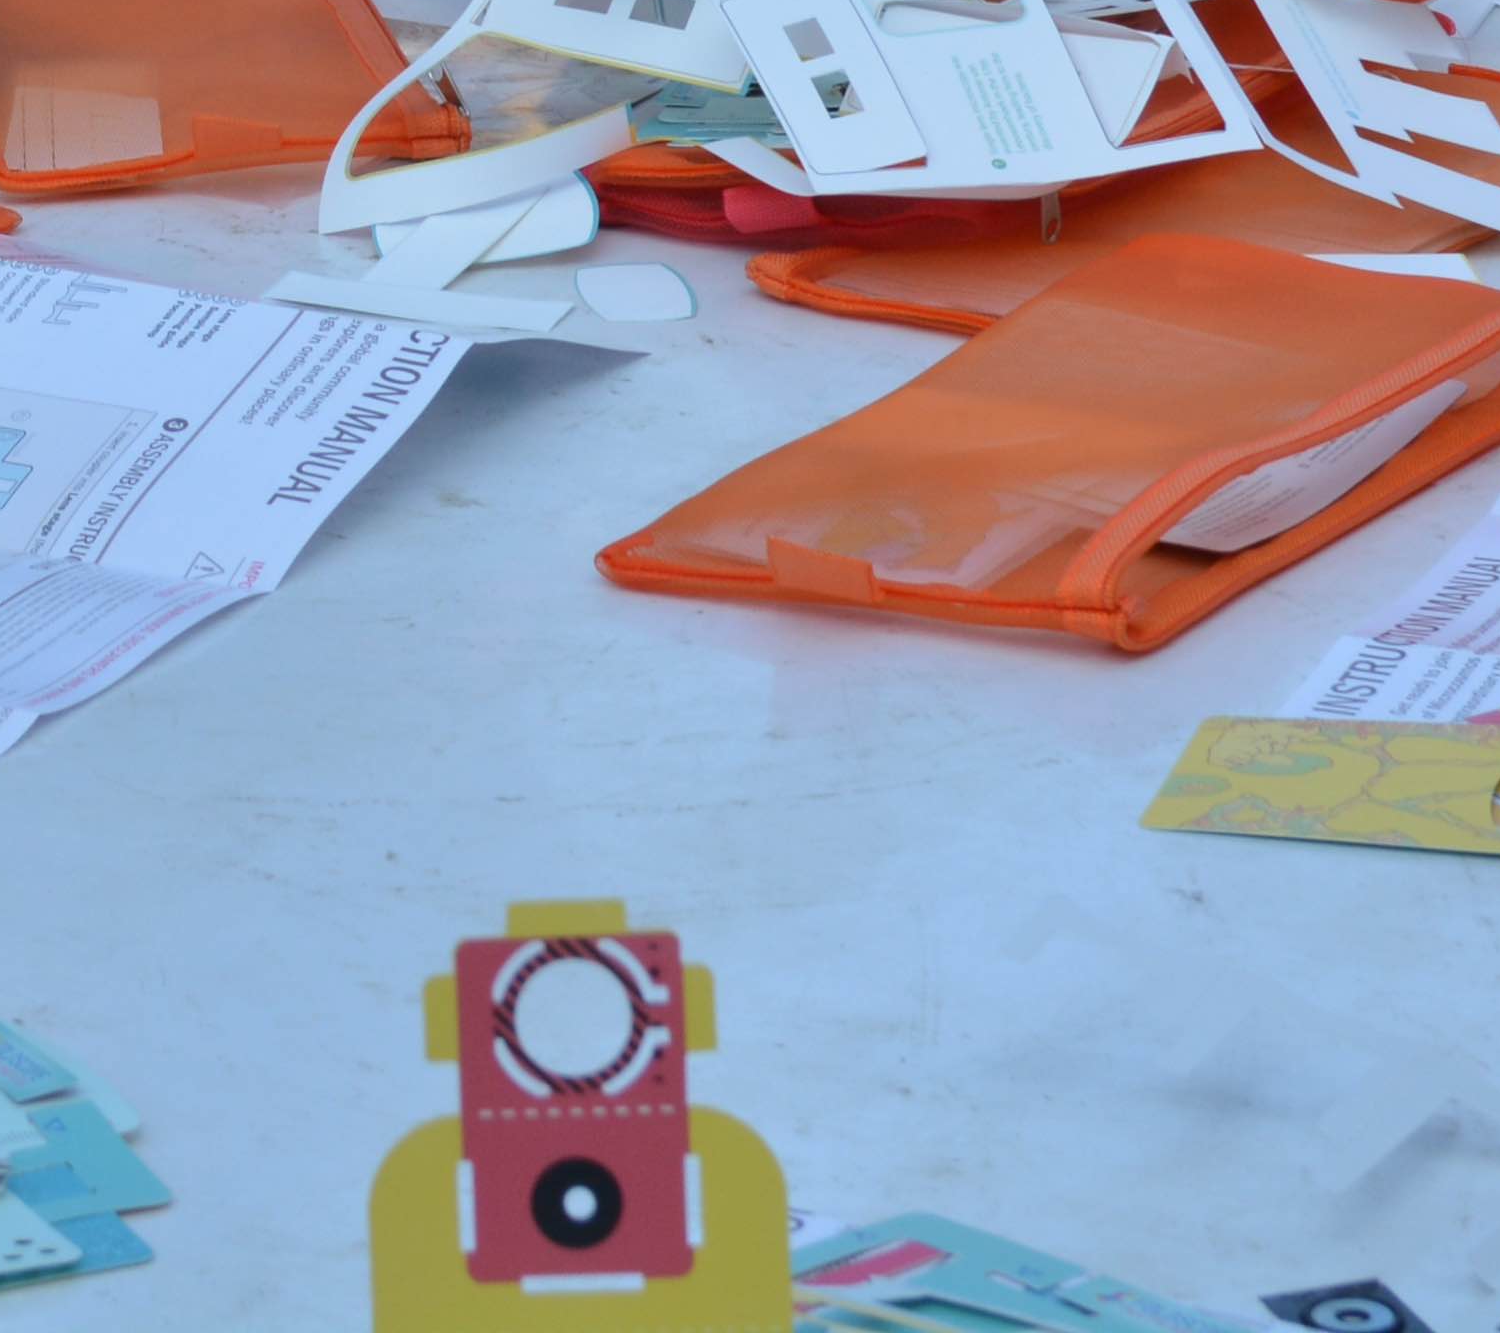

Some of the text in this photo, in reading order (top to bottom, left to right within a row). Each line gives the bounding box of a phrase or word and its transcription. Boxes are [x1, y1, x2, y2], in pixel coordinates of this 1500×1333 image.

[268, 342, 317, 389] ordinary
[343, 330, 383, 368] global
[292, 361, 355, 426] community
[300, 362, 327, 387] and
[262, 382, 310, 431] discover
[100, 434, 175, 505] ASSEMBLY
[266, 405, 392, 510] MANUAL
